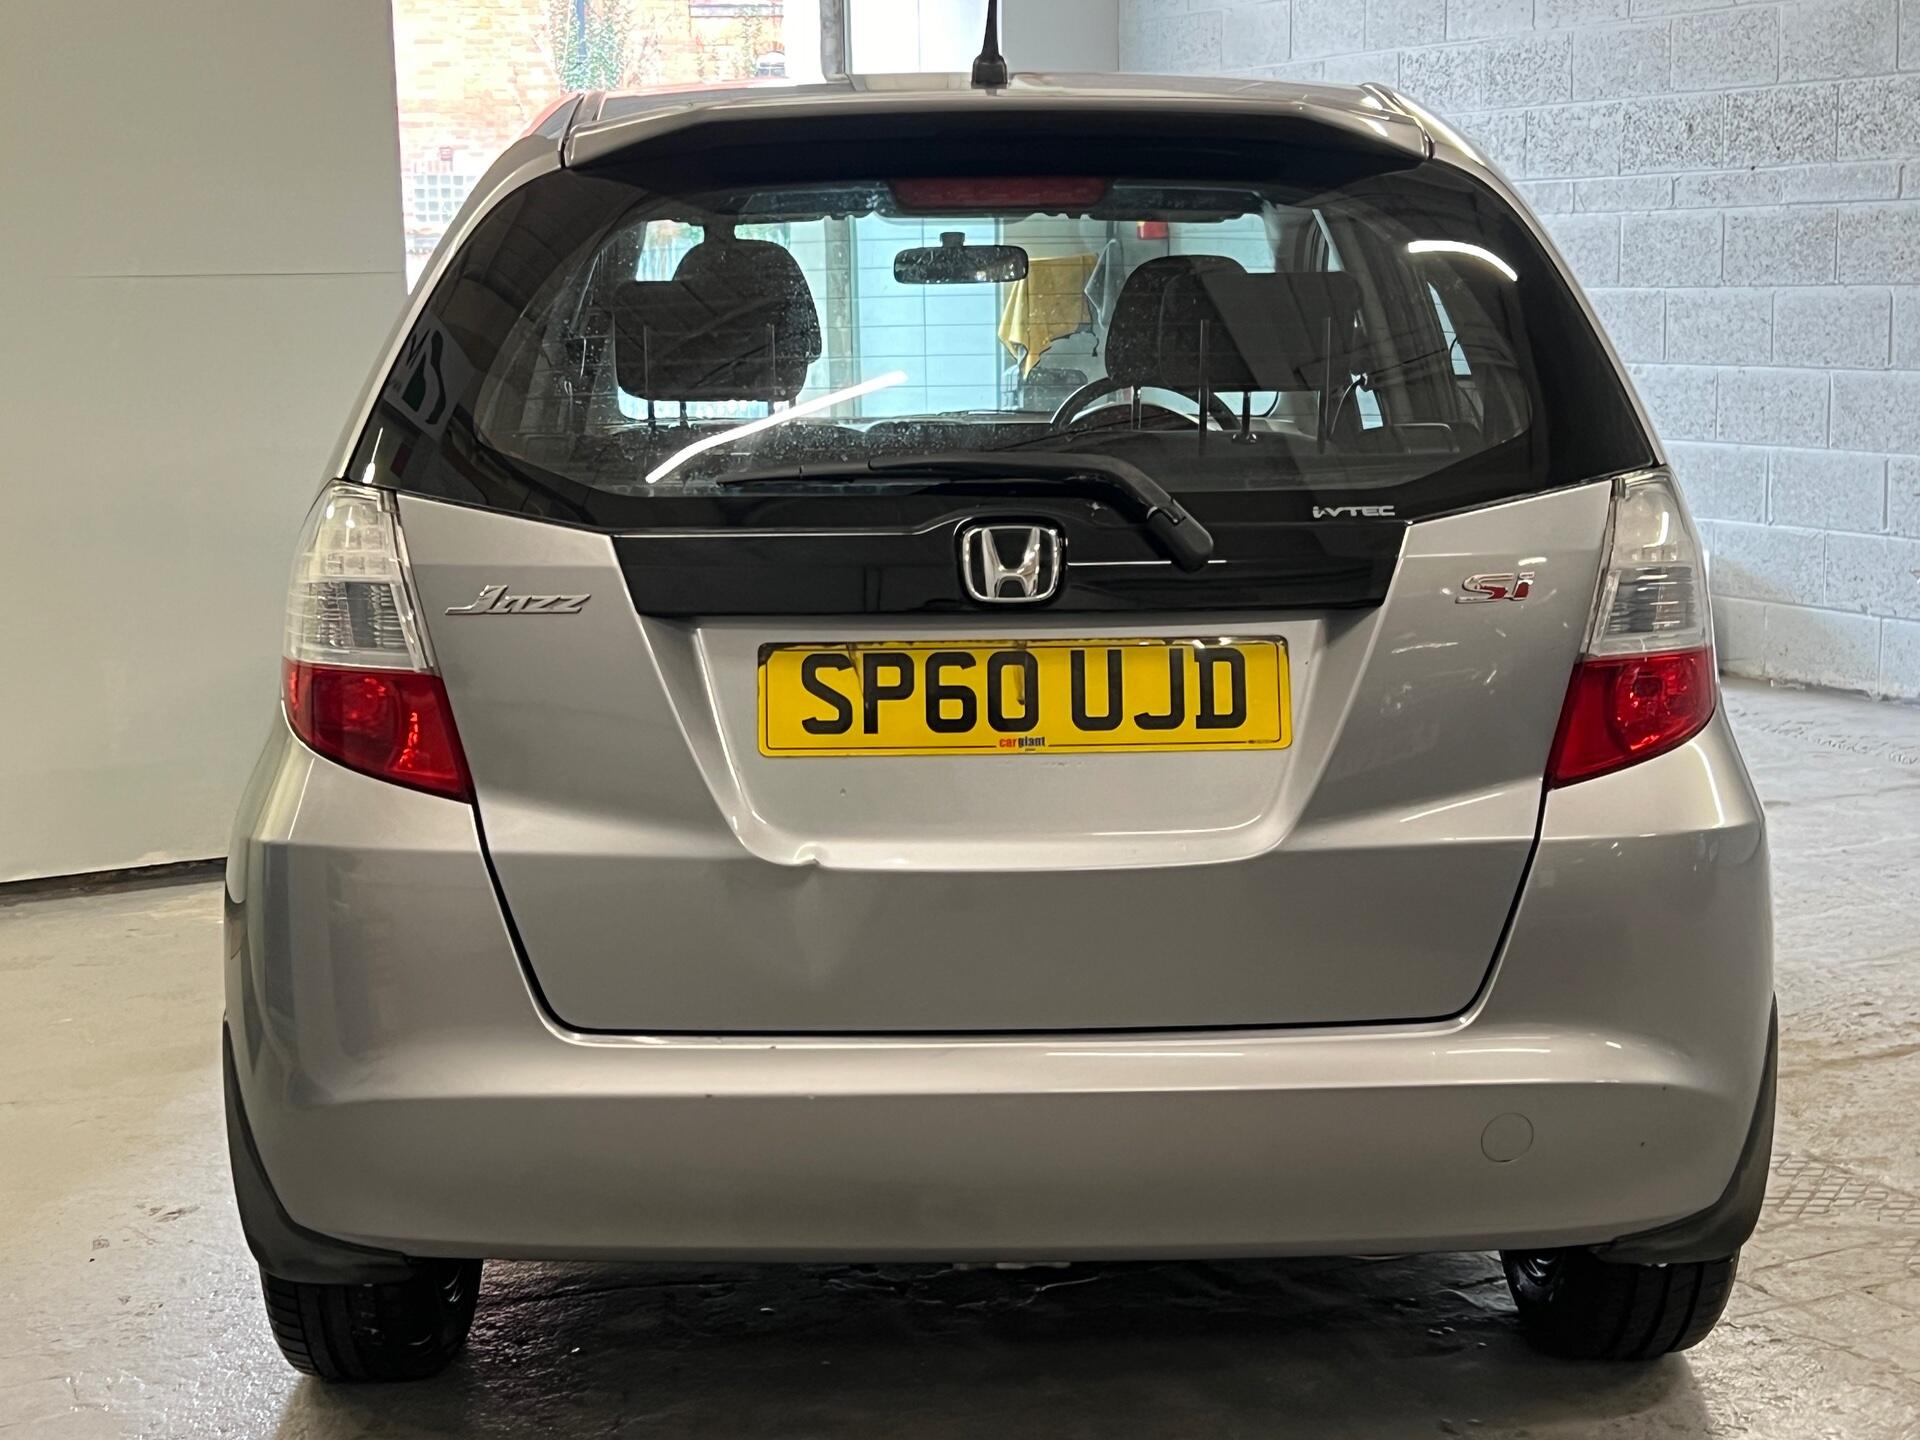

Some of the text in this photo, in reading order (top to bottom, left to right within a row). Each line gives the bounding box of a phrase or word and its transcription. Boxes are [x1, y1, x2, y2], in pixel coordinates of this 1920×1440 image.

[445, 585, 591, 615] Jazz
[1455, 571, 1535, 604] Si
[801, 648, 1247, 735] SP60 UJD
